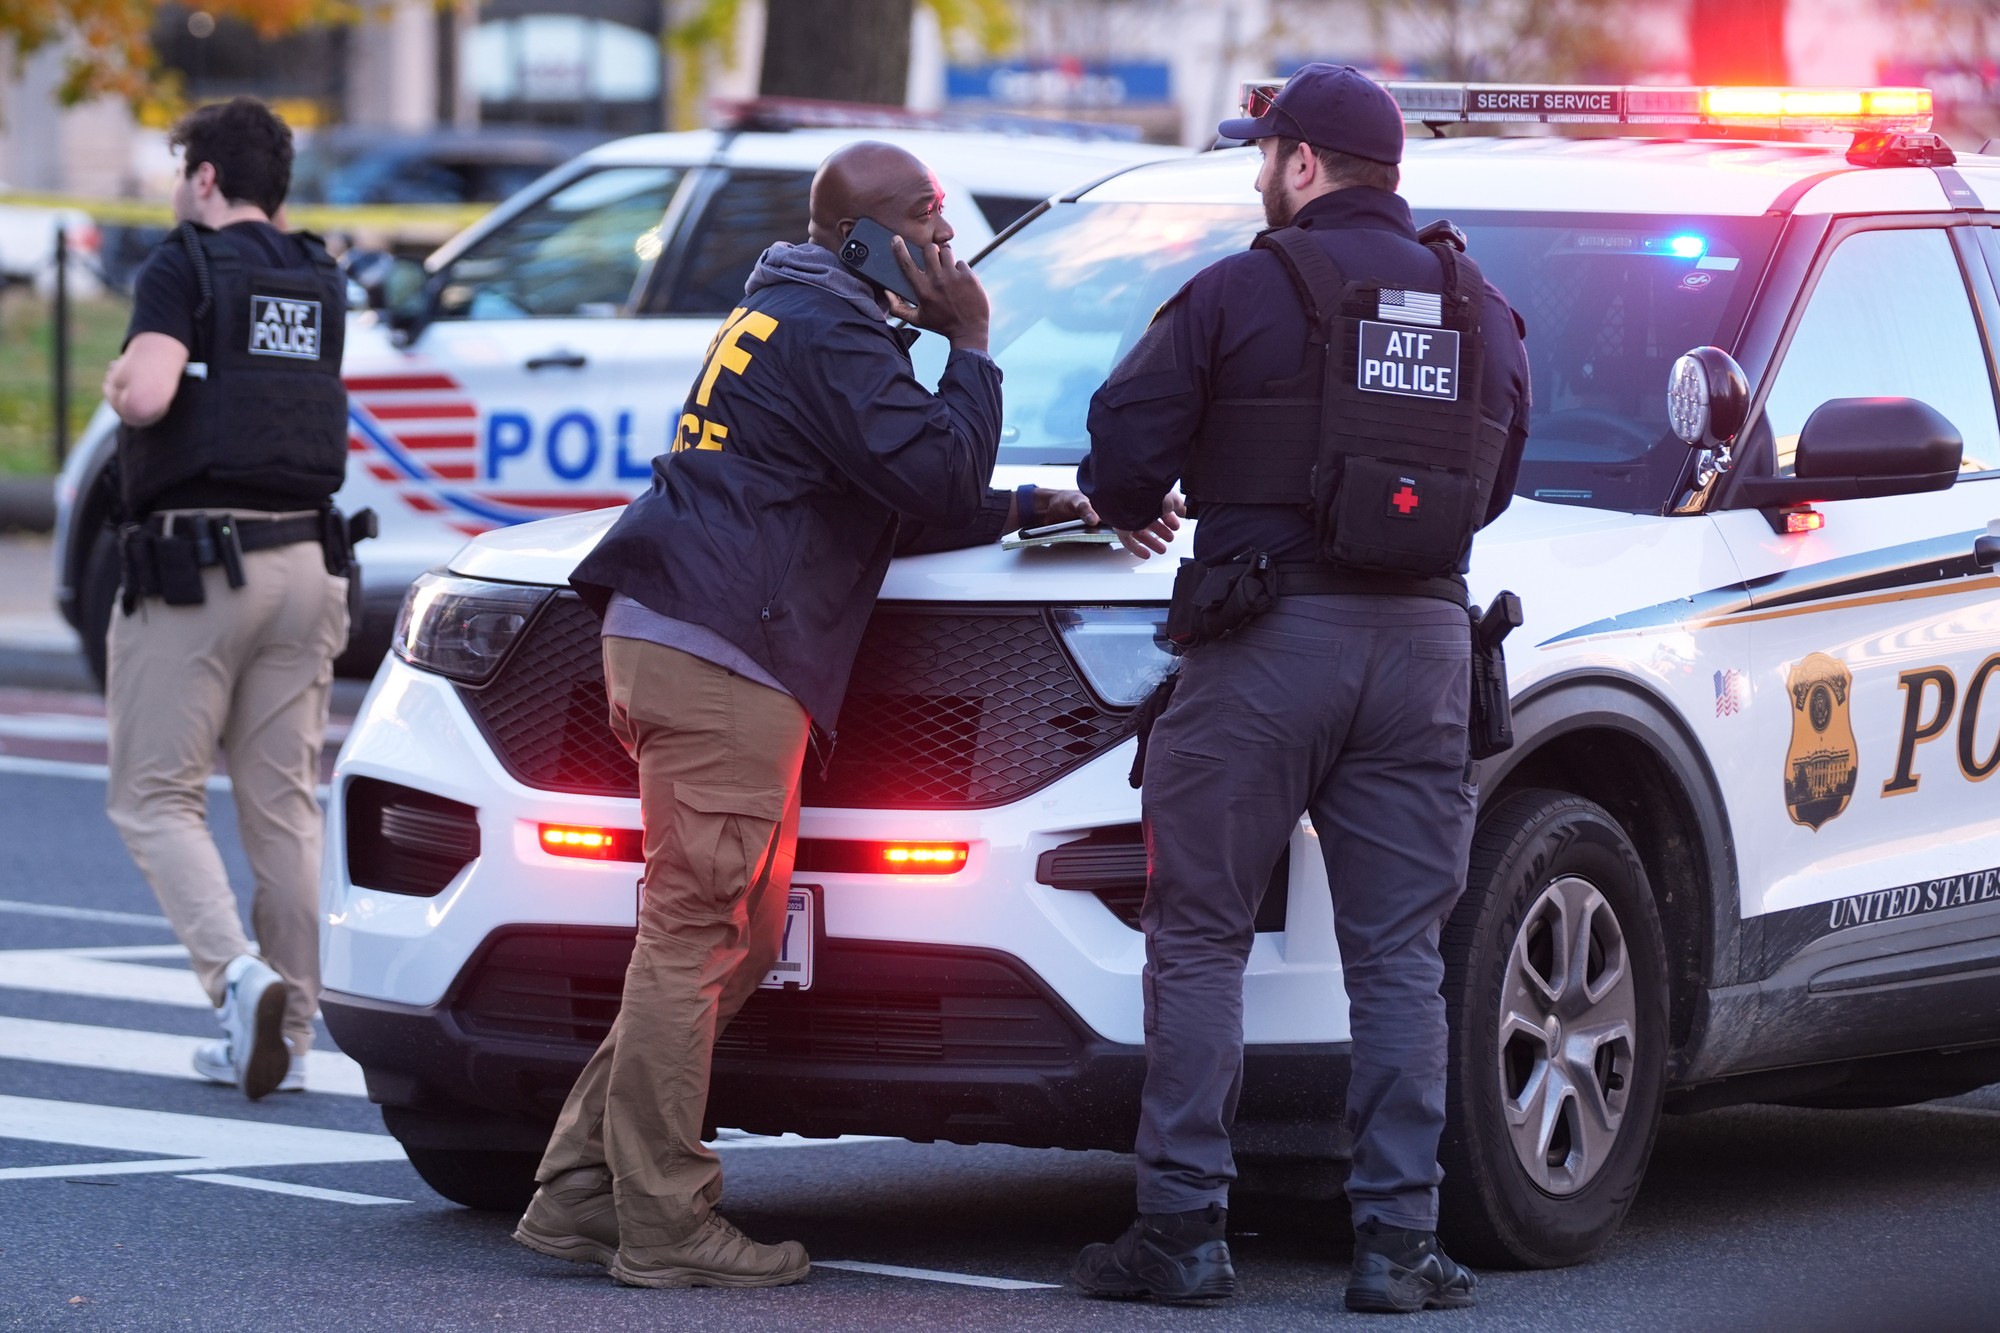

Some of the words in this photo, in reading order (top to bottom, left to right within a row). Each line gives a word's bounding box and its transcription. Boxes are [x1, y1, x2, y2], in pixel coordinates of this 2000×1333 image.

[1478, 93, 1539, 109] SECRET
[1544, 93, 1611, 109] SERVICE
[263, 301, 311, 326] ATF
[253, 322, 317, 354] POLICE
[1386, 330, 1433, 360] ATF
[1365, 359, 1452, 394] POLICE
[488, 411, 681, 480] POL
[1881, 652, 2000, 798] PO
[1830, 886, 1921, 929] UNITED
